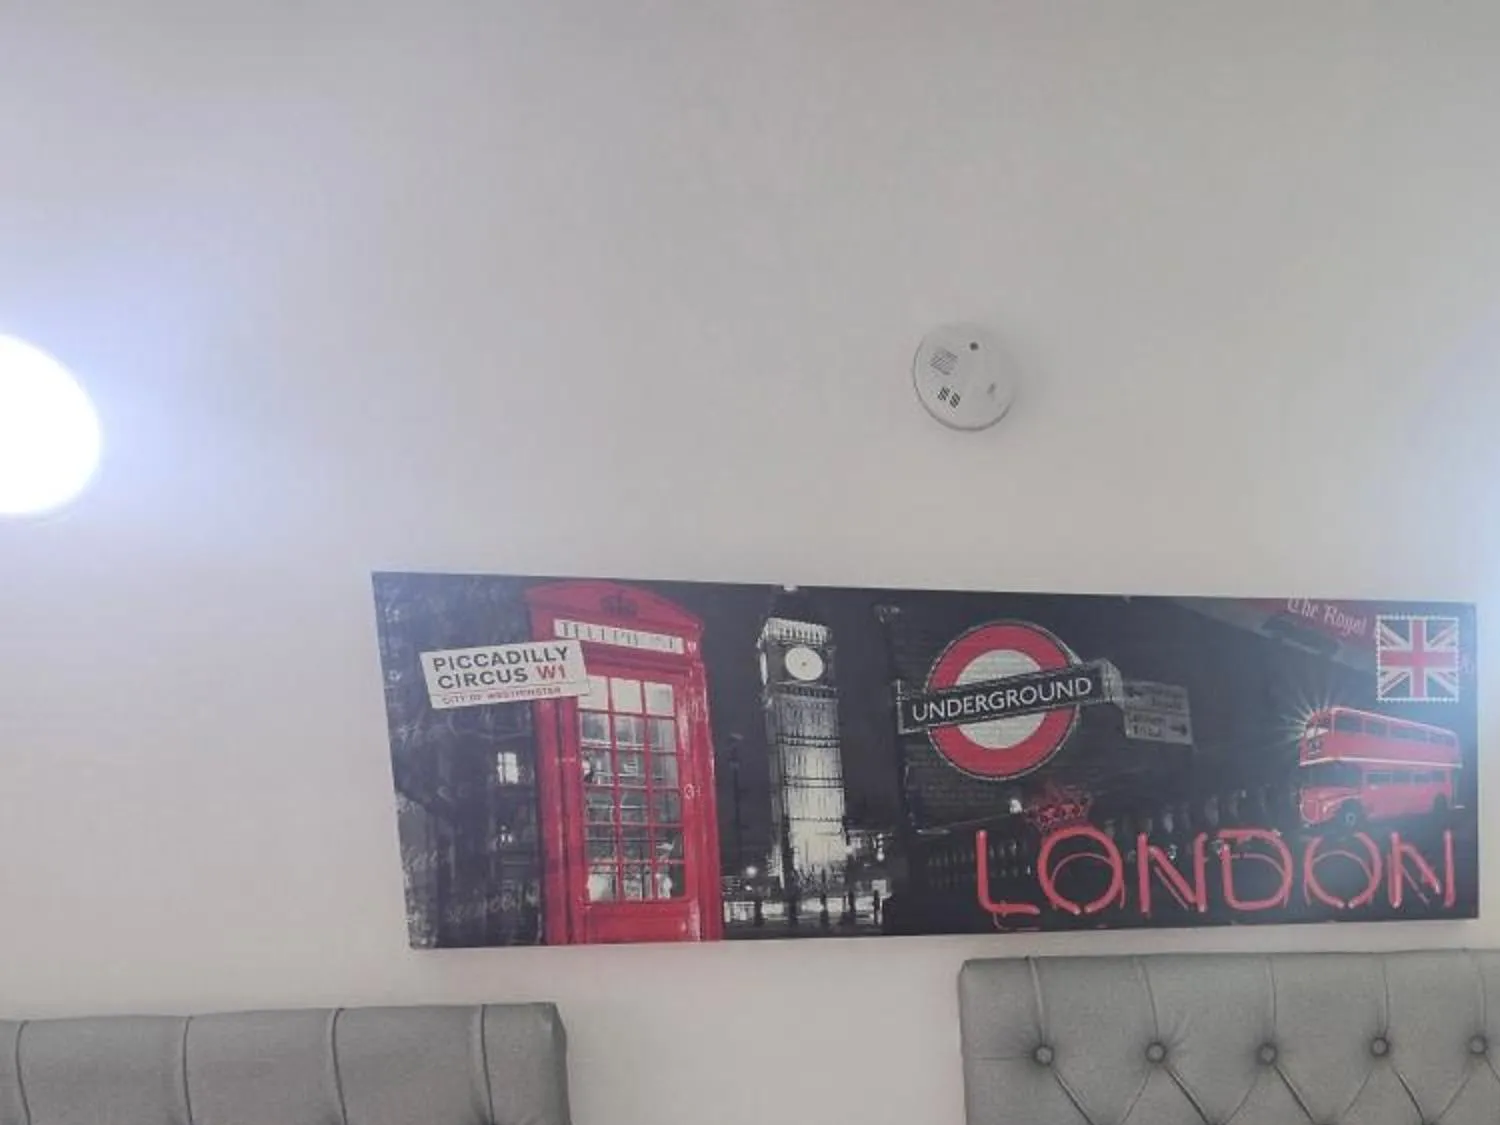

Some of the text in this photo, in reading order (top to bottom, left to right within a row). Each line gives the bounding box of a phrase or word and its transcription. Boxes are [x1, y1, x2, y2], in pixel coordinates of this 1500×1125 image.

[433, 646, 568, 672] PICCADILLY
[438, 665, 566, 689] CIRCUS W1
[912, 677, 1092, 721] UNDERGROUND
[976, 826, 1456, 915] LONDON
